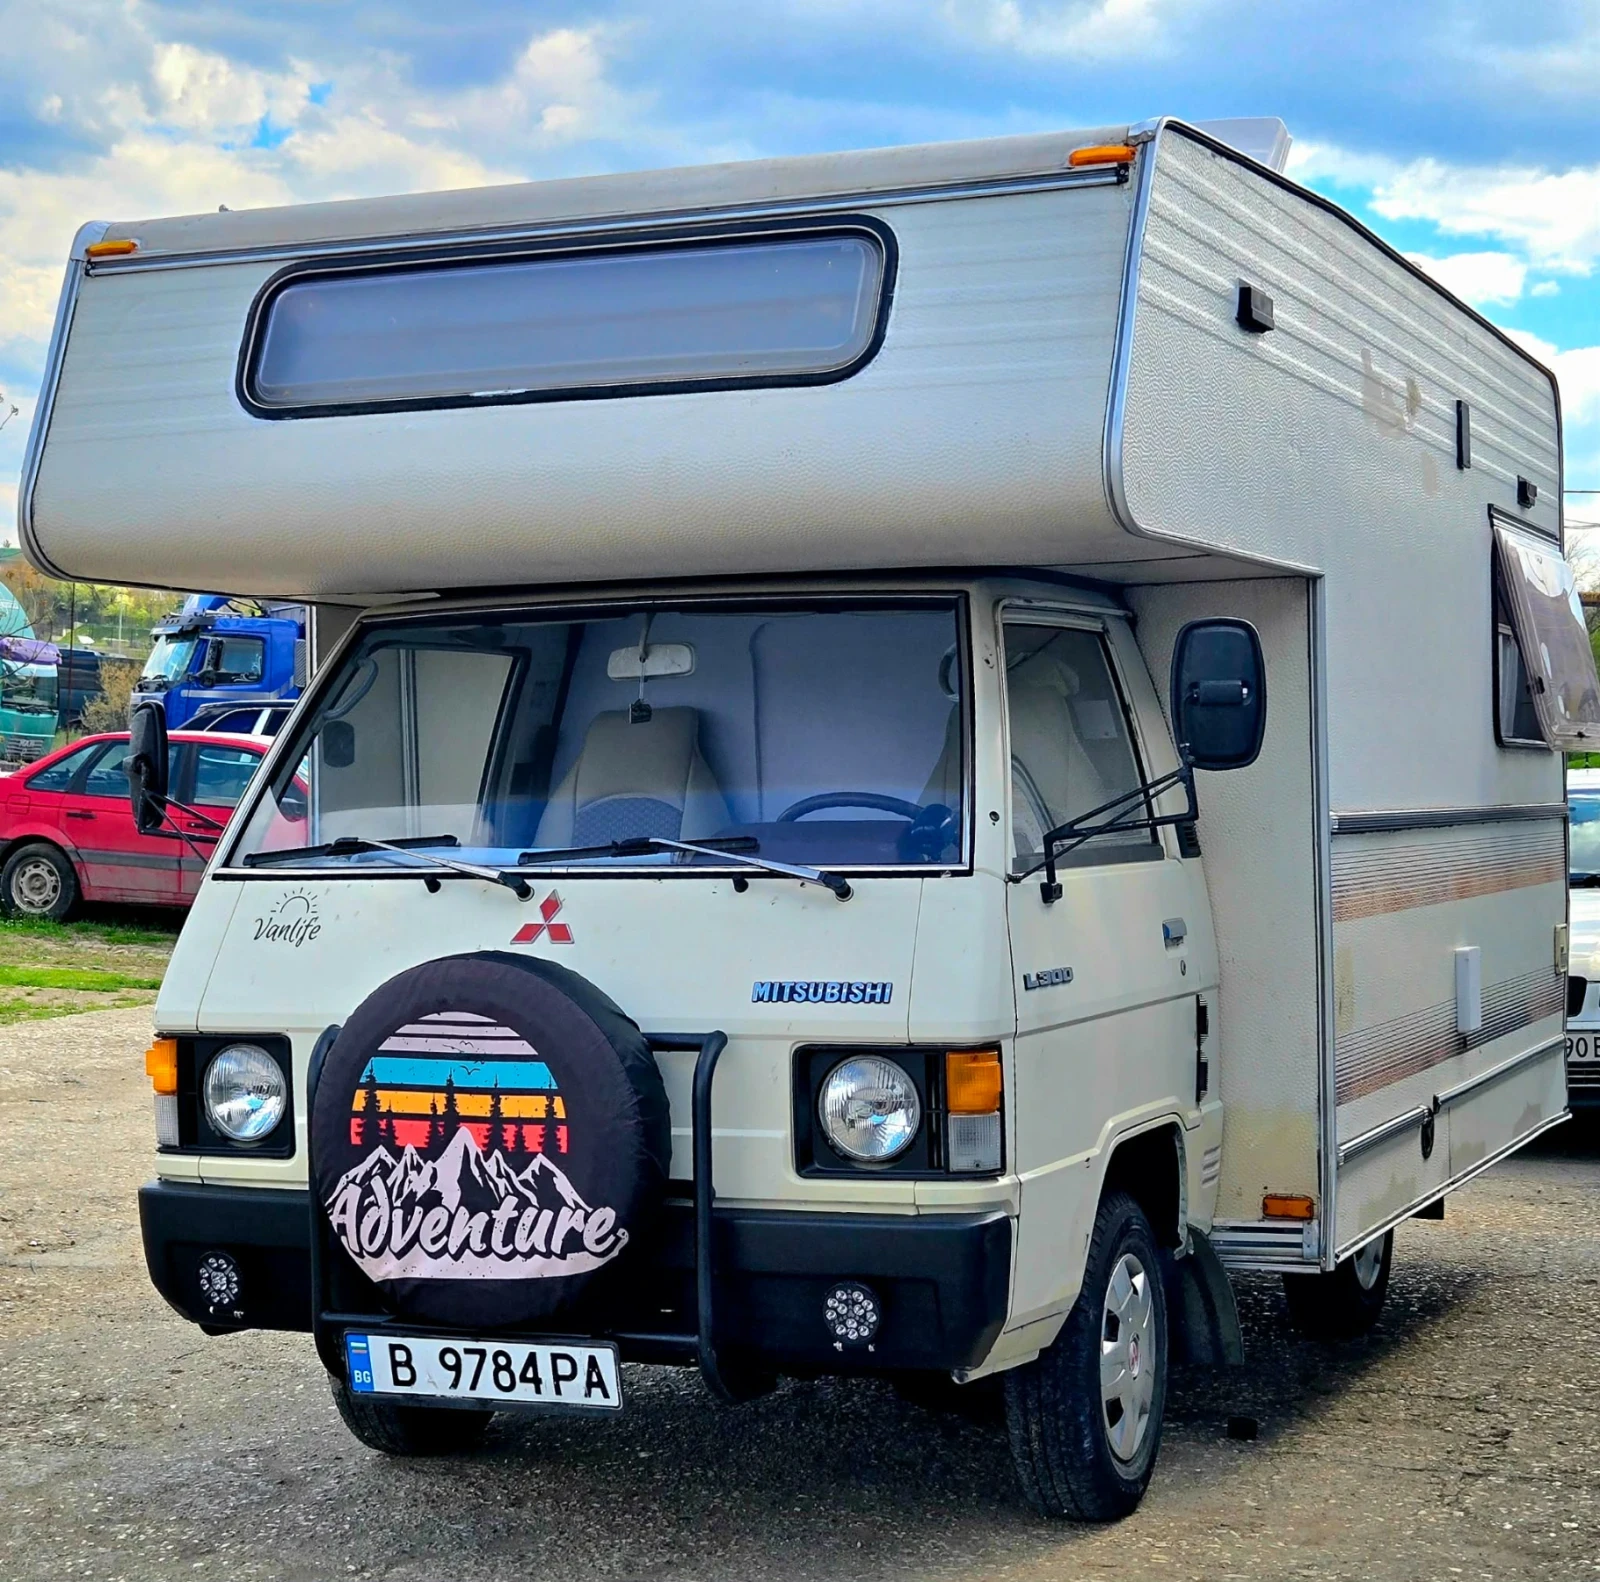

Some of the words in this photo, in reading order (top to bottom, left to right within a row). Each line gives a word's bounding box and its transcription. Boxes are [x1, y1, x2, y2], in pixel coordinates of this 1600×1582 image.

[253, 916, 322, 948] Vanlife
[751, 981, 893, 1004] MITSUBISHI
[1022, 966, 1074, 991] L300
[328, 1174, 617, 1255] Adventure
[354, 1371, 371, 1384] BG
[388, 1343, 417, 1387] B
[438, 1347, 611, 1400] 9784PA
